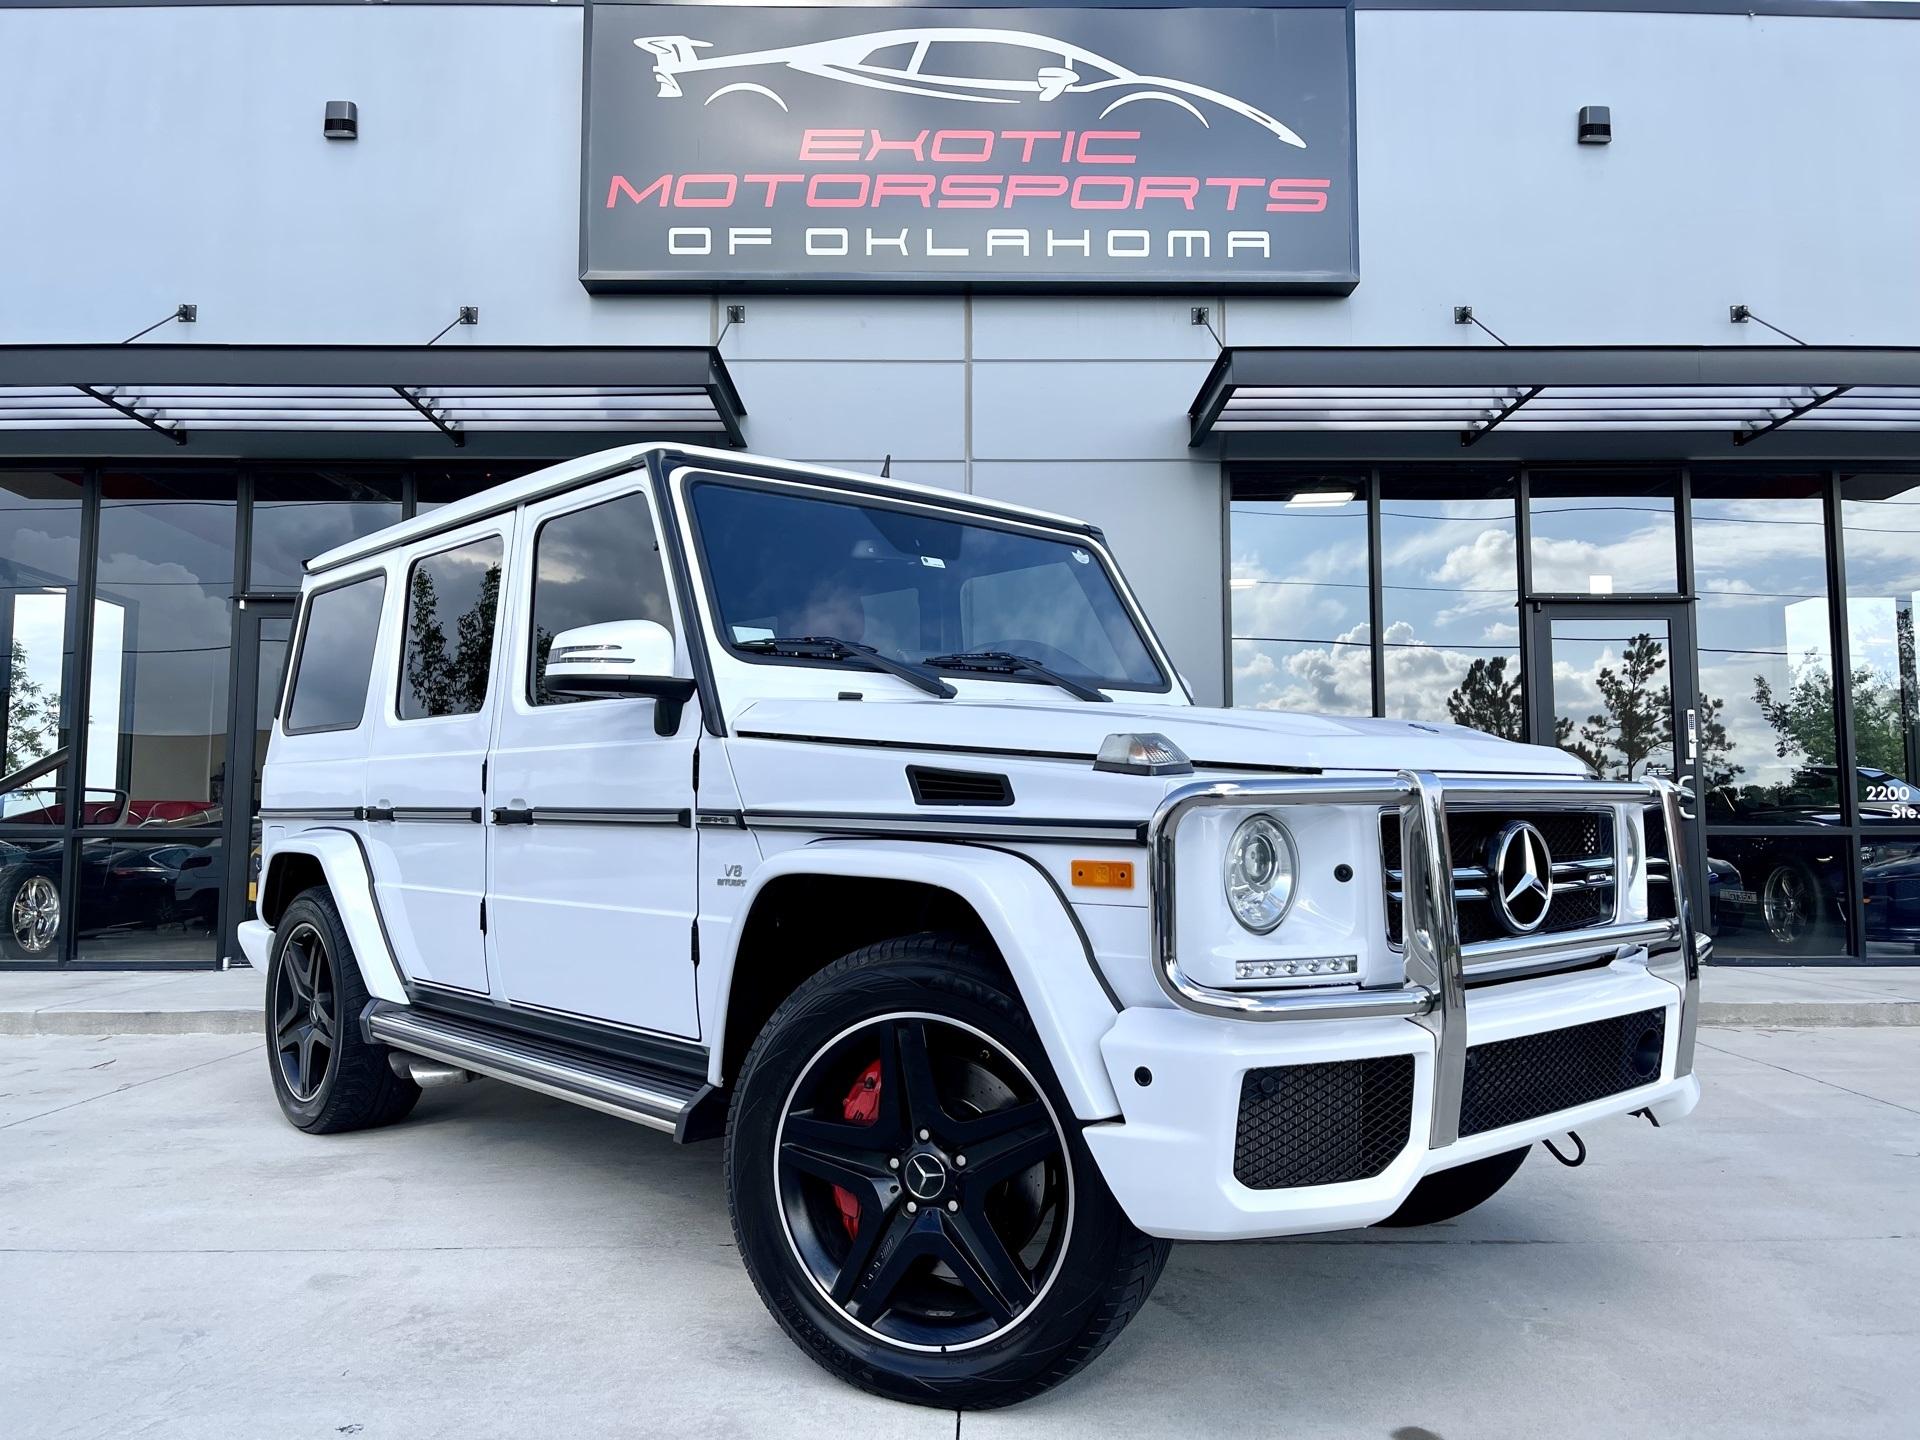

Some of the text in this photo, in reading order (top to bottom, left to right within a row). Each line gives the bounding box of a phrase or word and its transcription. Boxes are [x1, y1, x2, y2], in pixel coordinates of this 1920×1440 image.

[799, 129, 1141, 164] EXOTIC
[606, 173, 1331, 213] MOTORSPORTS
[668, 227, 1270, 258] OF OKLAHOMA
[1866, 785, 1910, 801] 2200
[724, 864, 743, 877] V8
